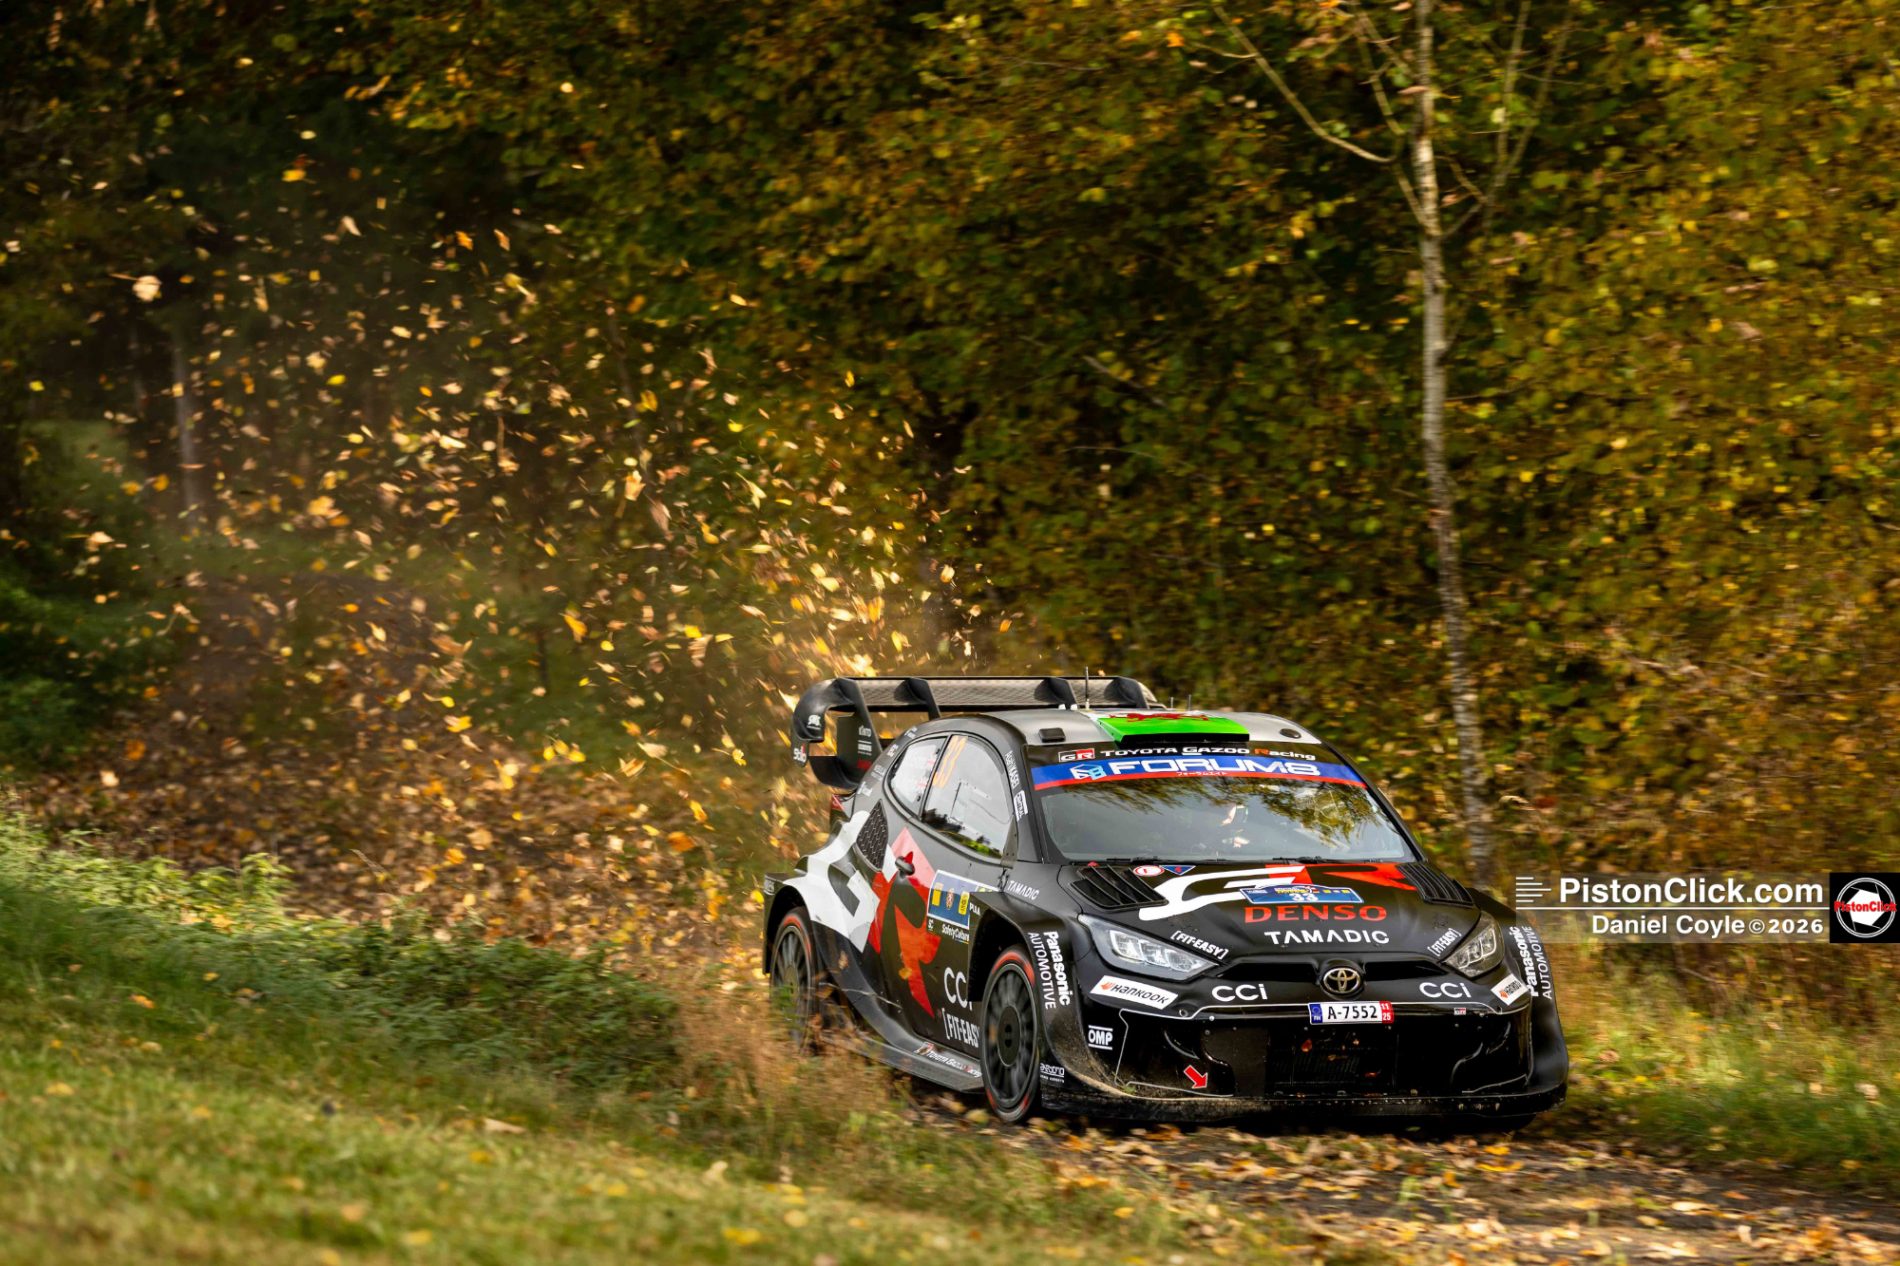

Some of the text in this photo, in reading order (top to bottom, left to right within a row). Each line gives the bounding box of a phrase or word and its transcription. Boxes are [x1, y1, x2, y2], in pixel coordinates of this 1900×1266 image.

[1060, 750, 1093, 761] GR
[1100, 746, 1316, 761] TOYOTA GAZOO Racing
[1108, 758, 1320, 776] FORUM8
[1007, 880, 1040, 901] TAMADIC
[1244, 905, 1388, 924] DENSO
[1264, 929, 1390, 945] TAMADIC
[1028, 931, 1057, 1010] AUTOMOTIVE
[1043, 930, 1074, 1006] Panasonic
[1508, 926, 1540, 997] Panasonic
[1521, 925, 1553, 1000] AUTOMOTIVE
[1327, 1005, 1378, 1020] A-7552
[1382, 1012, 1392, 1021] 25
[1088, 1029, 1113, 1046] OMP
